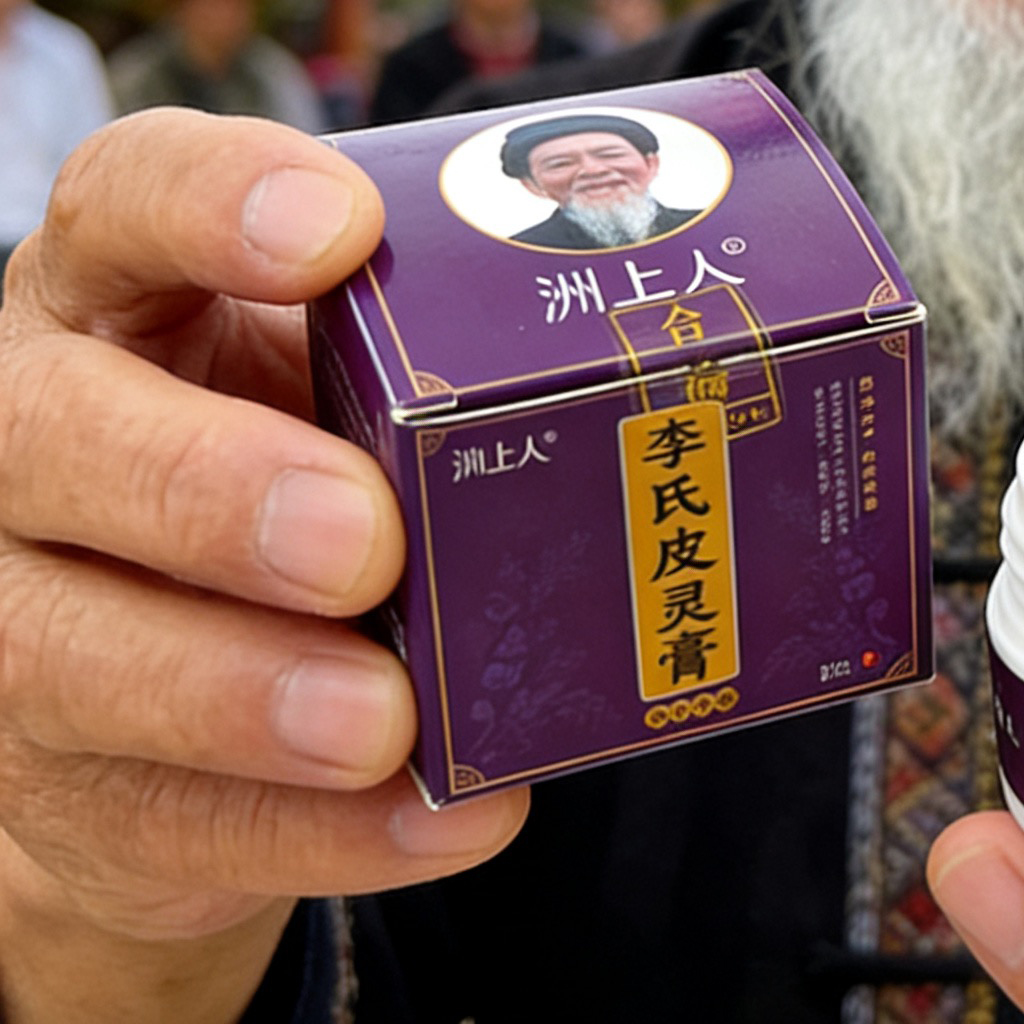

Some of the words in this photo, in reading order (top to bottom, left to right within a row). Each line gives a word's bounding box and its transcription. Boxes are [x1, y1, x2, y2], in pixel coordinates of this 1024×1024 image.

[536, 249, 746, 324] 洲上人
[642, 418, 720, 685] 李氏皮灵膏
